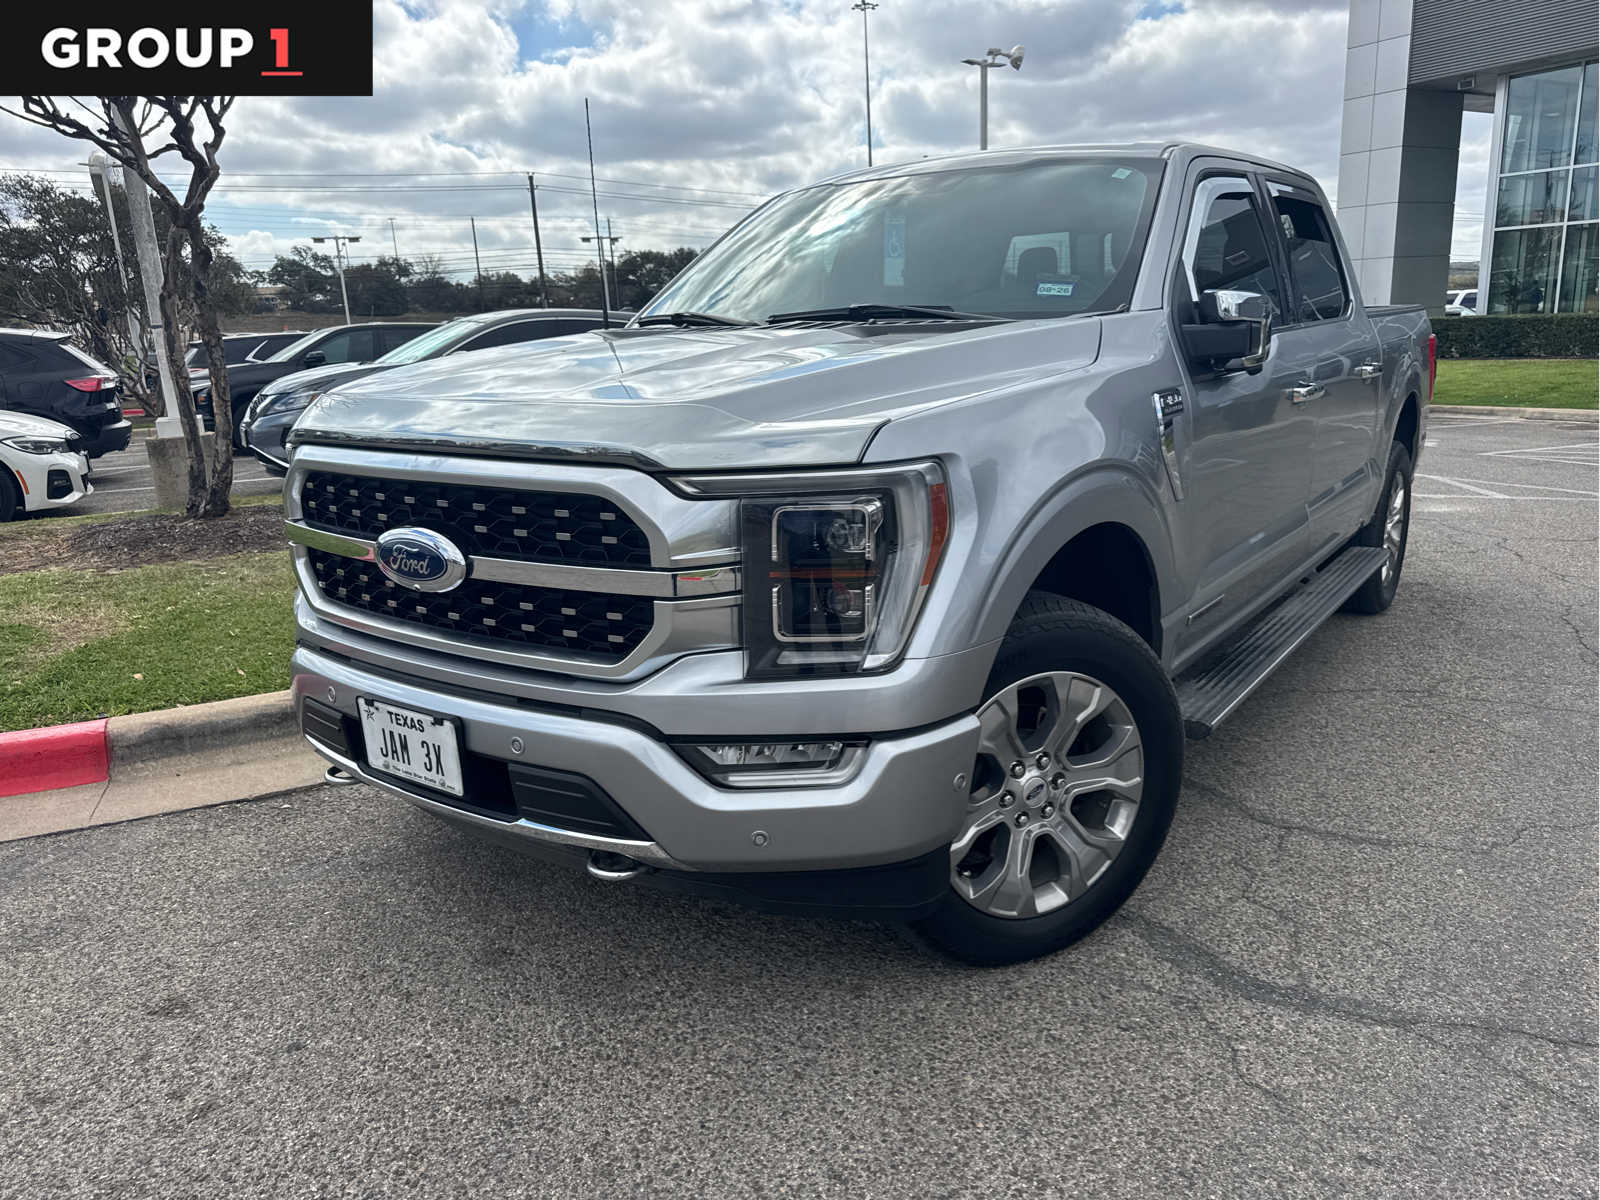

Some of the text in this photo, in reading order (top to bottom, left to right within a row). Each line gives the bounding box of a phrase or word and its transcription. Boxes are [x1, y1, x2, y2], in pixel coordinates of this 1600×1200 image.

[390, 544, 431, 575] Ford
[387, 710, 424, 732] TEXAS
[380, 728, 445, 777] JAM 3X
